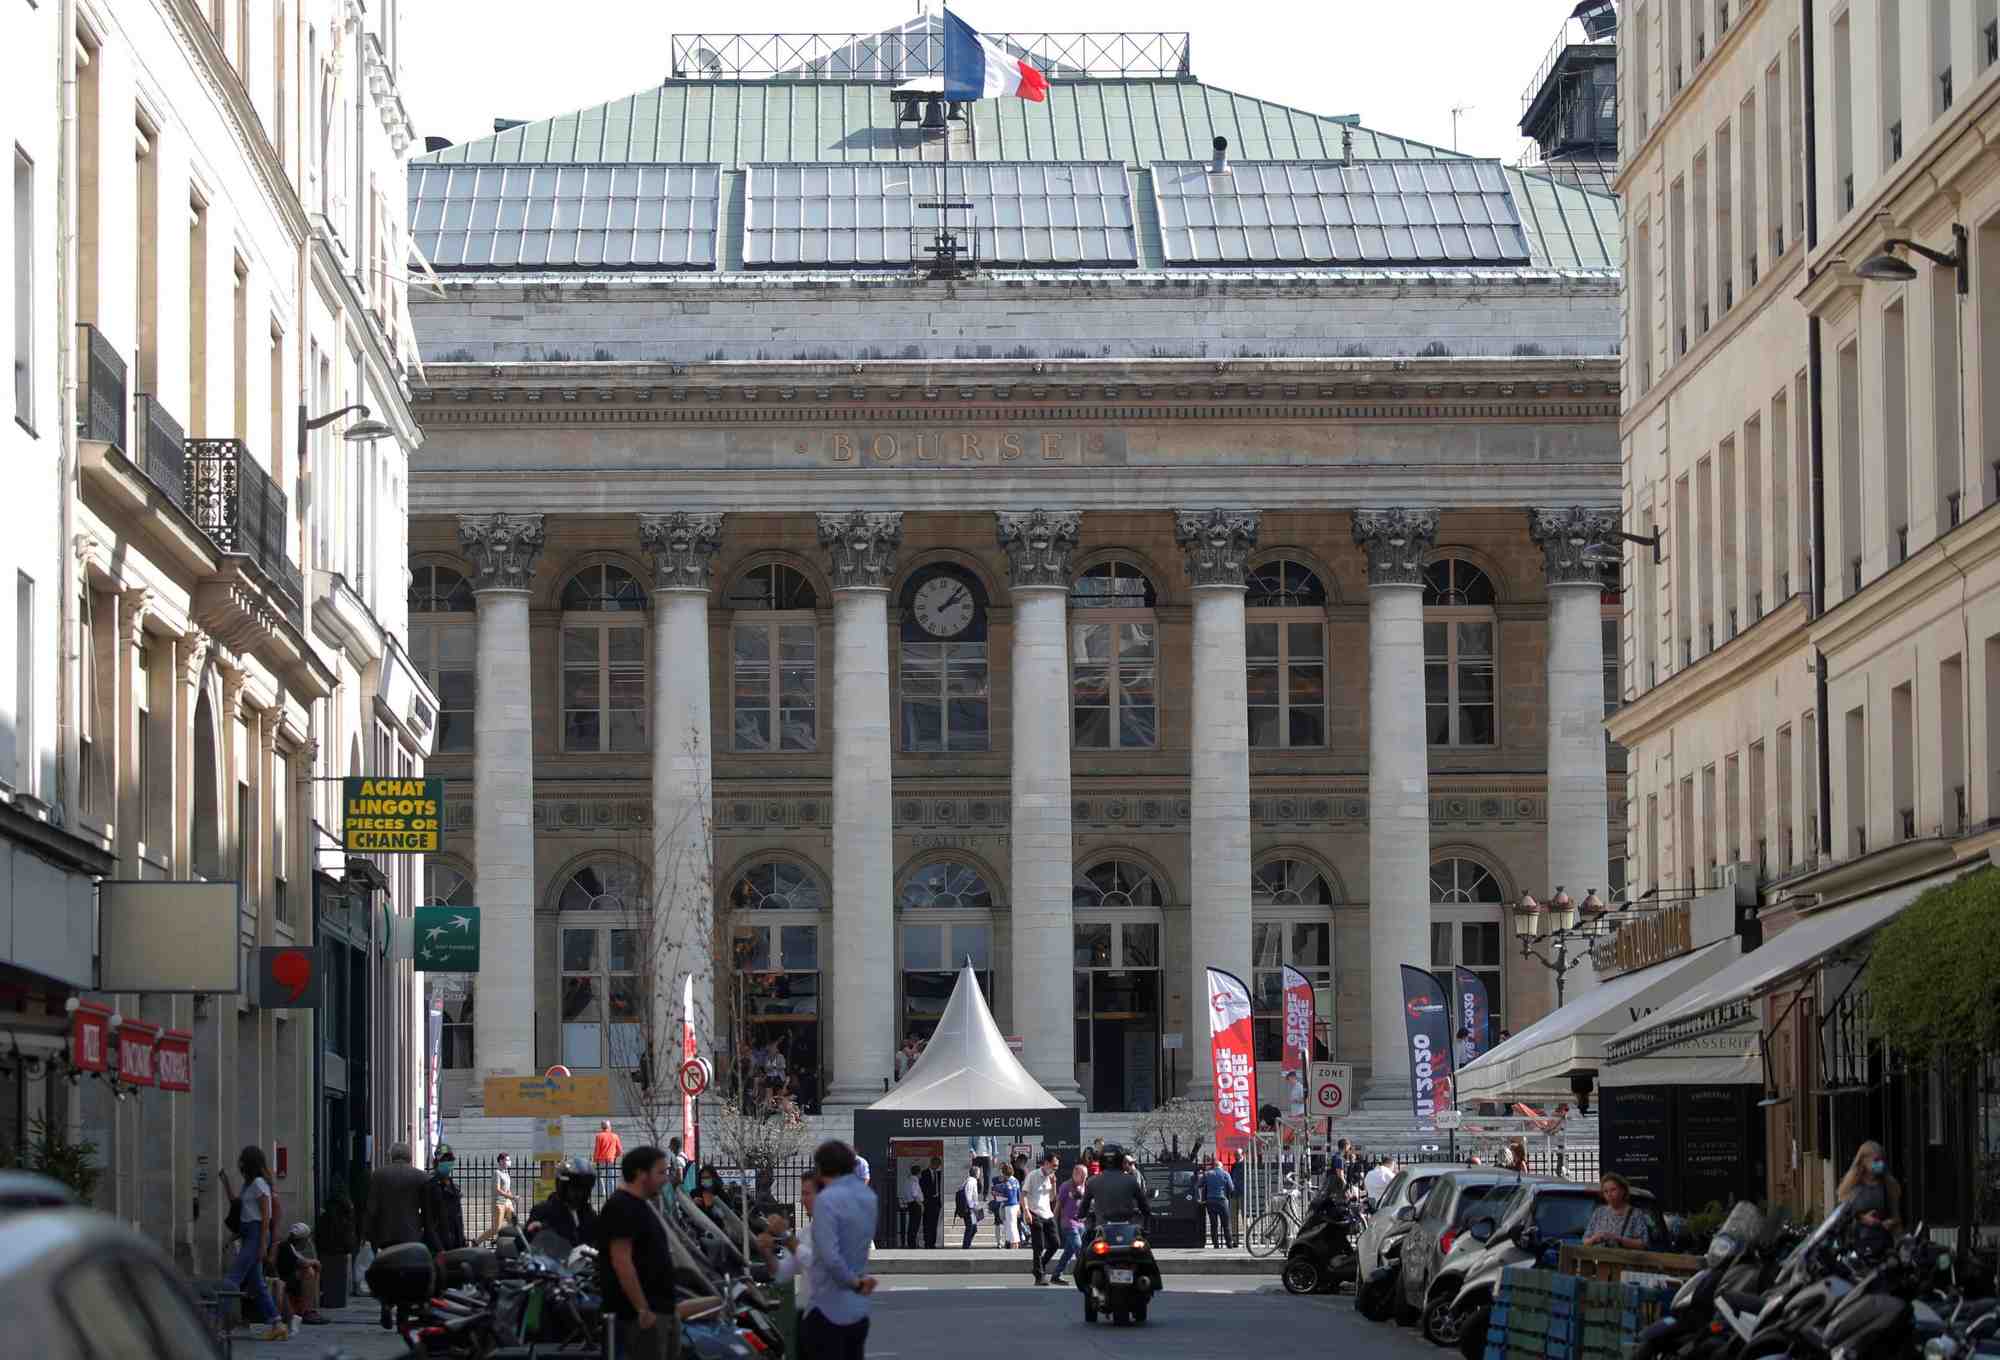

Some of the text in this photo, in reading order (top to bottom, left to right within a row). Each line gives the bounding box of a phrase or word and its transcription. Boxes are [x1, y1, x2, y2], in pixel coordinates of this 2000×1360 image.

[832, 433, 1064, 461] BOURSE
[360, 780, 426, 796] ACHAT
[349, 799, 437, 815] LINGOTS
[346, 818, 439, 830] PIECES OR
[356, 832, 428, 848] CHANGE
[1318, 1068, 1345, 1078] ZONE
[1323, 1090, 1338, 1101] 30
[903, 1117, 972, 1129] BIENVENUE
[982, 1117, 1041, 1128] WELCOME
